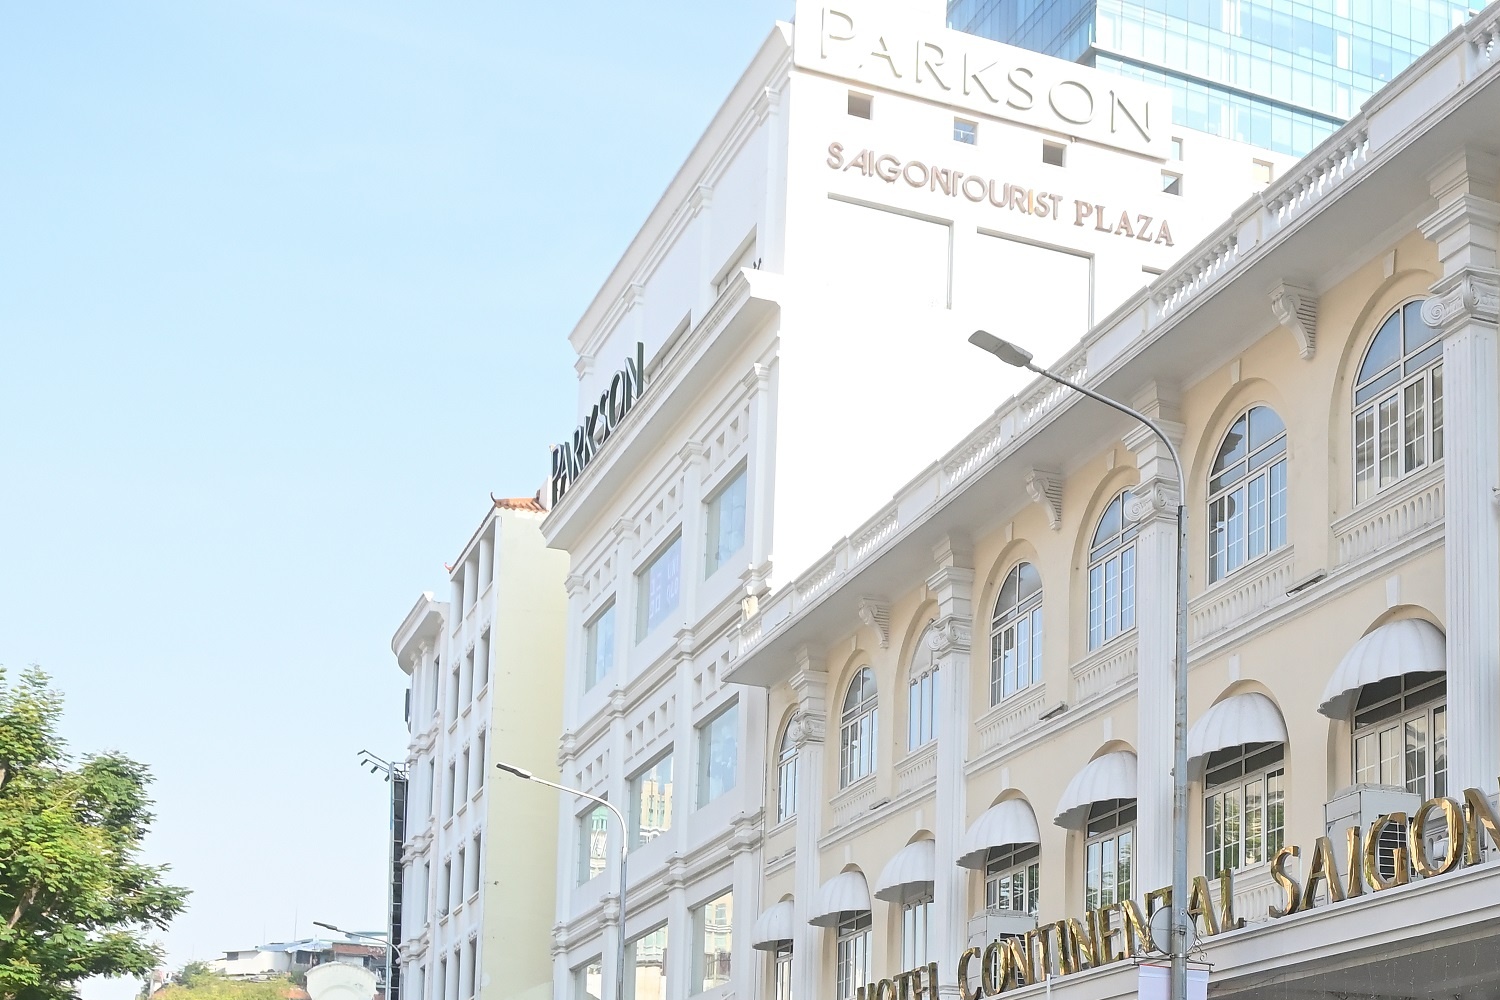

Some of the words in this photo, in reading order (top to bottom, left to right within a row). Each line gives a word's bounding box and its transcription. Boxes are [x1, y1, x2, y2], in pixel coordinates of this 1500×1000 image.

[820, 6, 1153, 143] PARKSON
[826, 141, 1063, 221] SAIGONTOURIST
[1073, 199, 1175, 248] PLAZA
[551, 342, 644, 508] PARKSON
